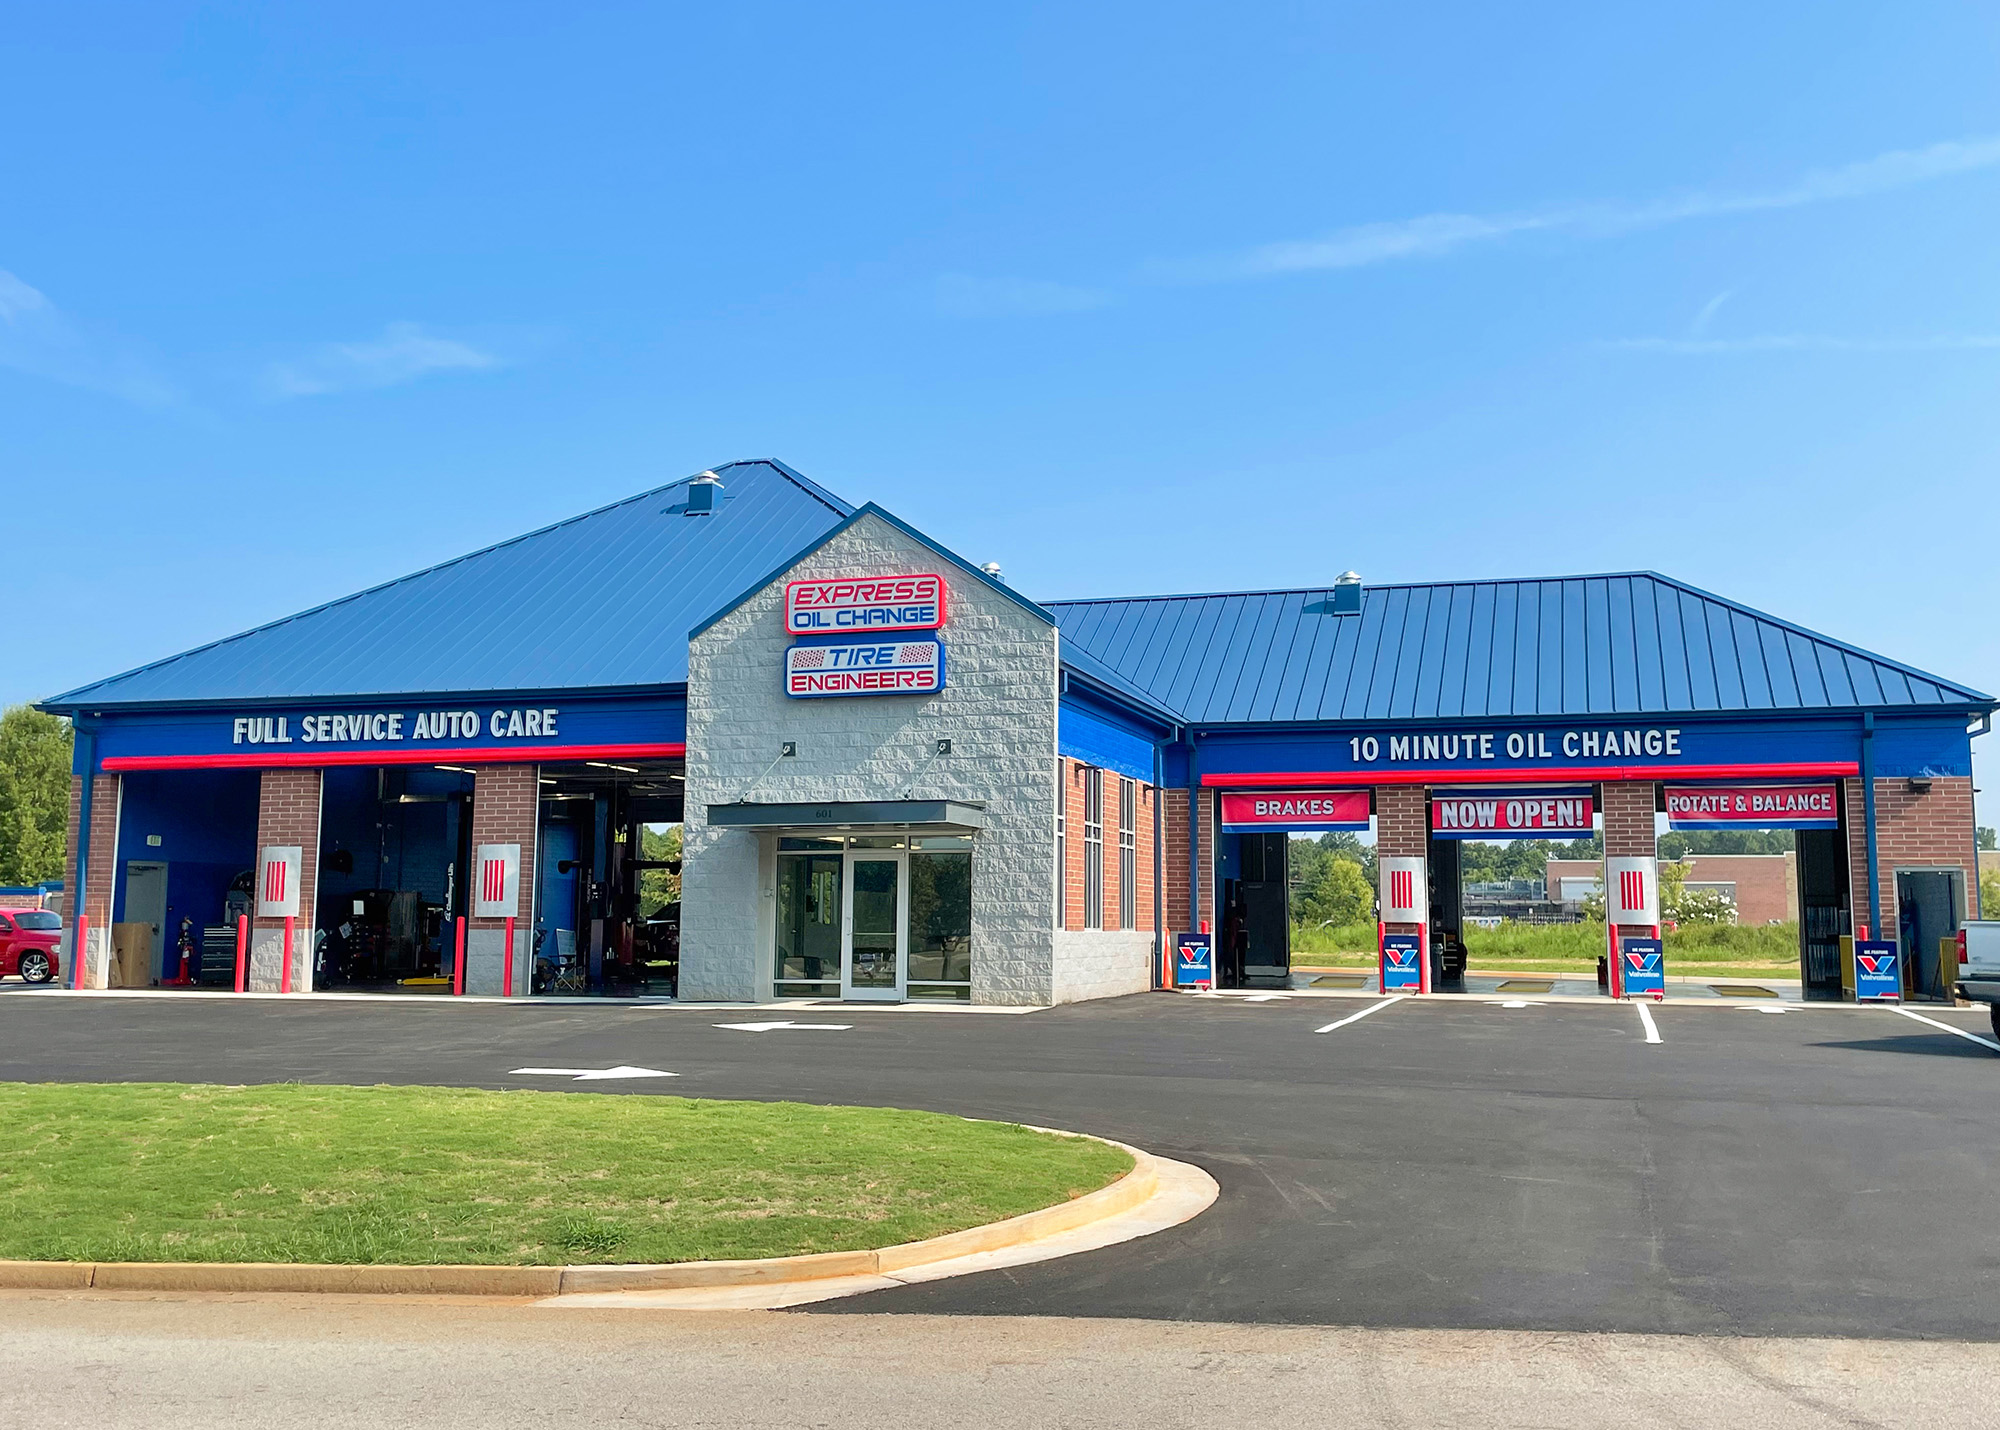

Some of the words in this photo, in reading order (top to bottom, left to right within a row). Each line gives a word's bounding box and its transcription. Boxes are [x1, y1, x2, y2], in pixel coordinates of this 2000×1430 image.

[795, 581, 936, 605] EXPRESS
[794, 611, 830, 628] OIL
[836, 606, 935, 626] CHANGE
[829, 646, 896, 667] TIRE
[791, 671, 935, 692] ENGINEERS
[233, 717, 293, 744] FULL
[302, 713, 404, 743] SERVICE
[413, 711, 481, 739] AUTO
[490, 709, 559, 738] CARE
[1349, 737, 1379, 762] 10
[1390, 734, 1495, 761] MINUTE
[1506, 733, 1553, 759] OIL
[1562, 729, 1681, 757] CHANGE
[816, 808, 831, 818] 601
[1255, 800, 1334, 816] BRAKES
[1441, 801, 1498, 828] NOW
[1506, 800, 1584, 827] OPEN!
[1668, 796, 1730, 813] ROTATE
[1735, 795, 1749, 812] &
[1752, 794, 1832, 812] BALANCE
